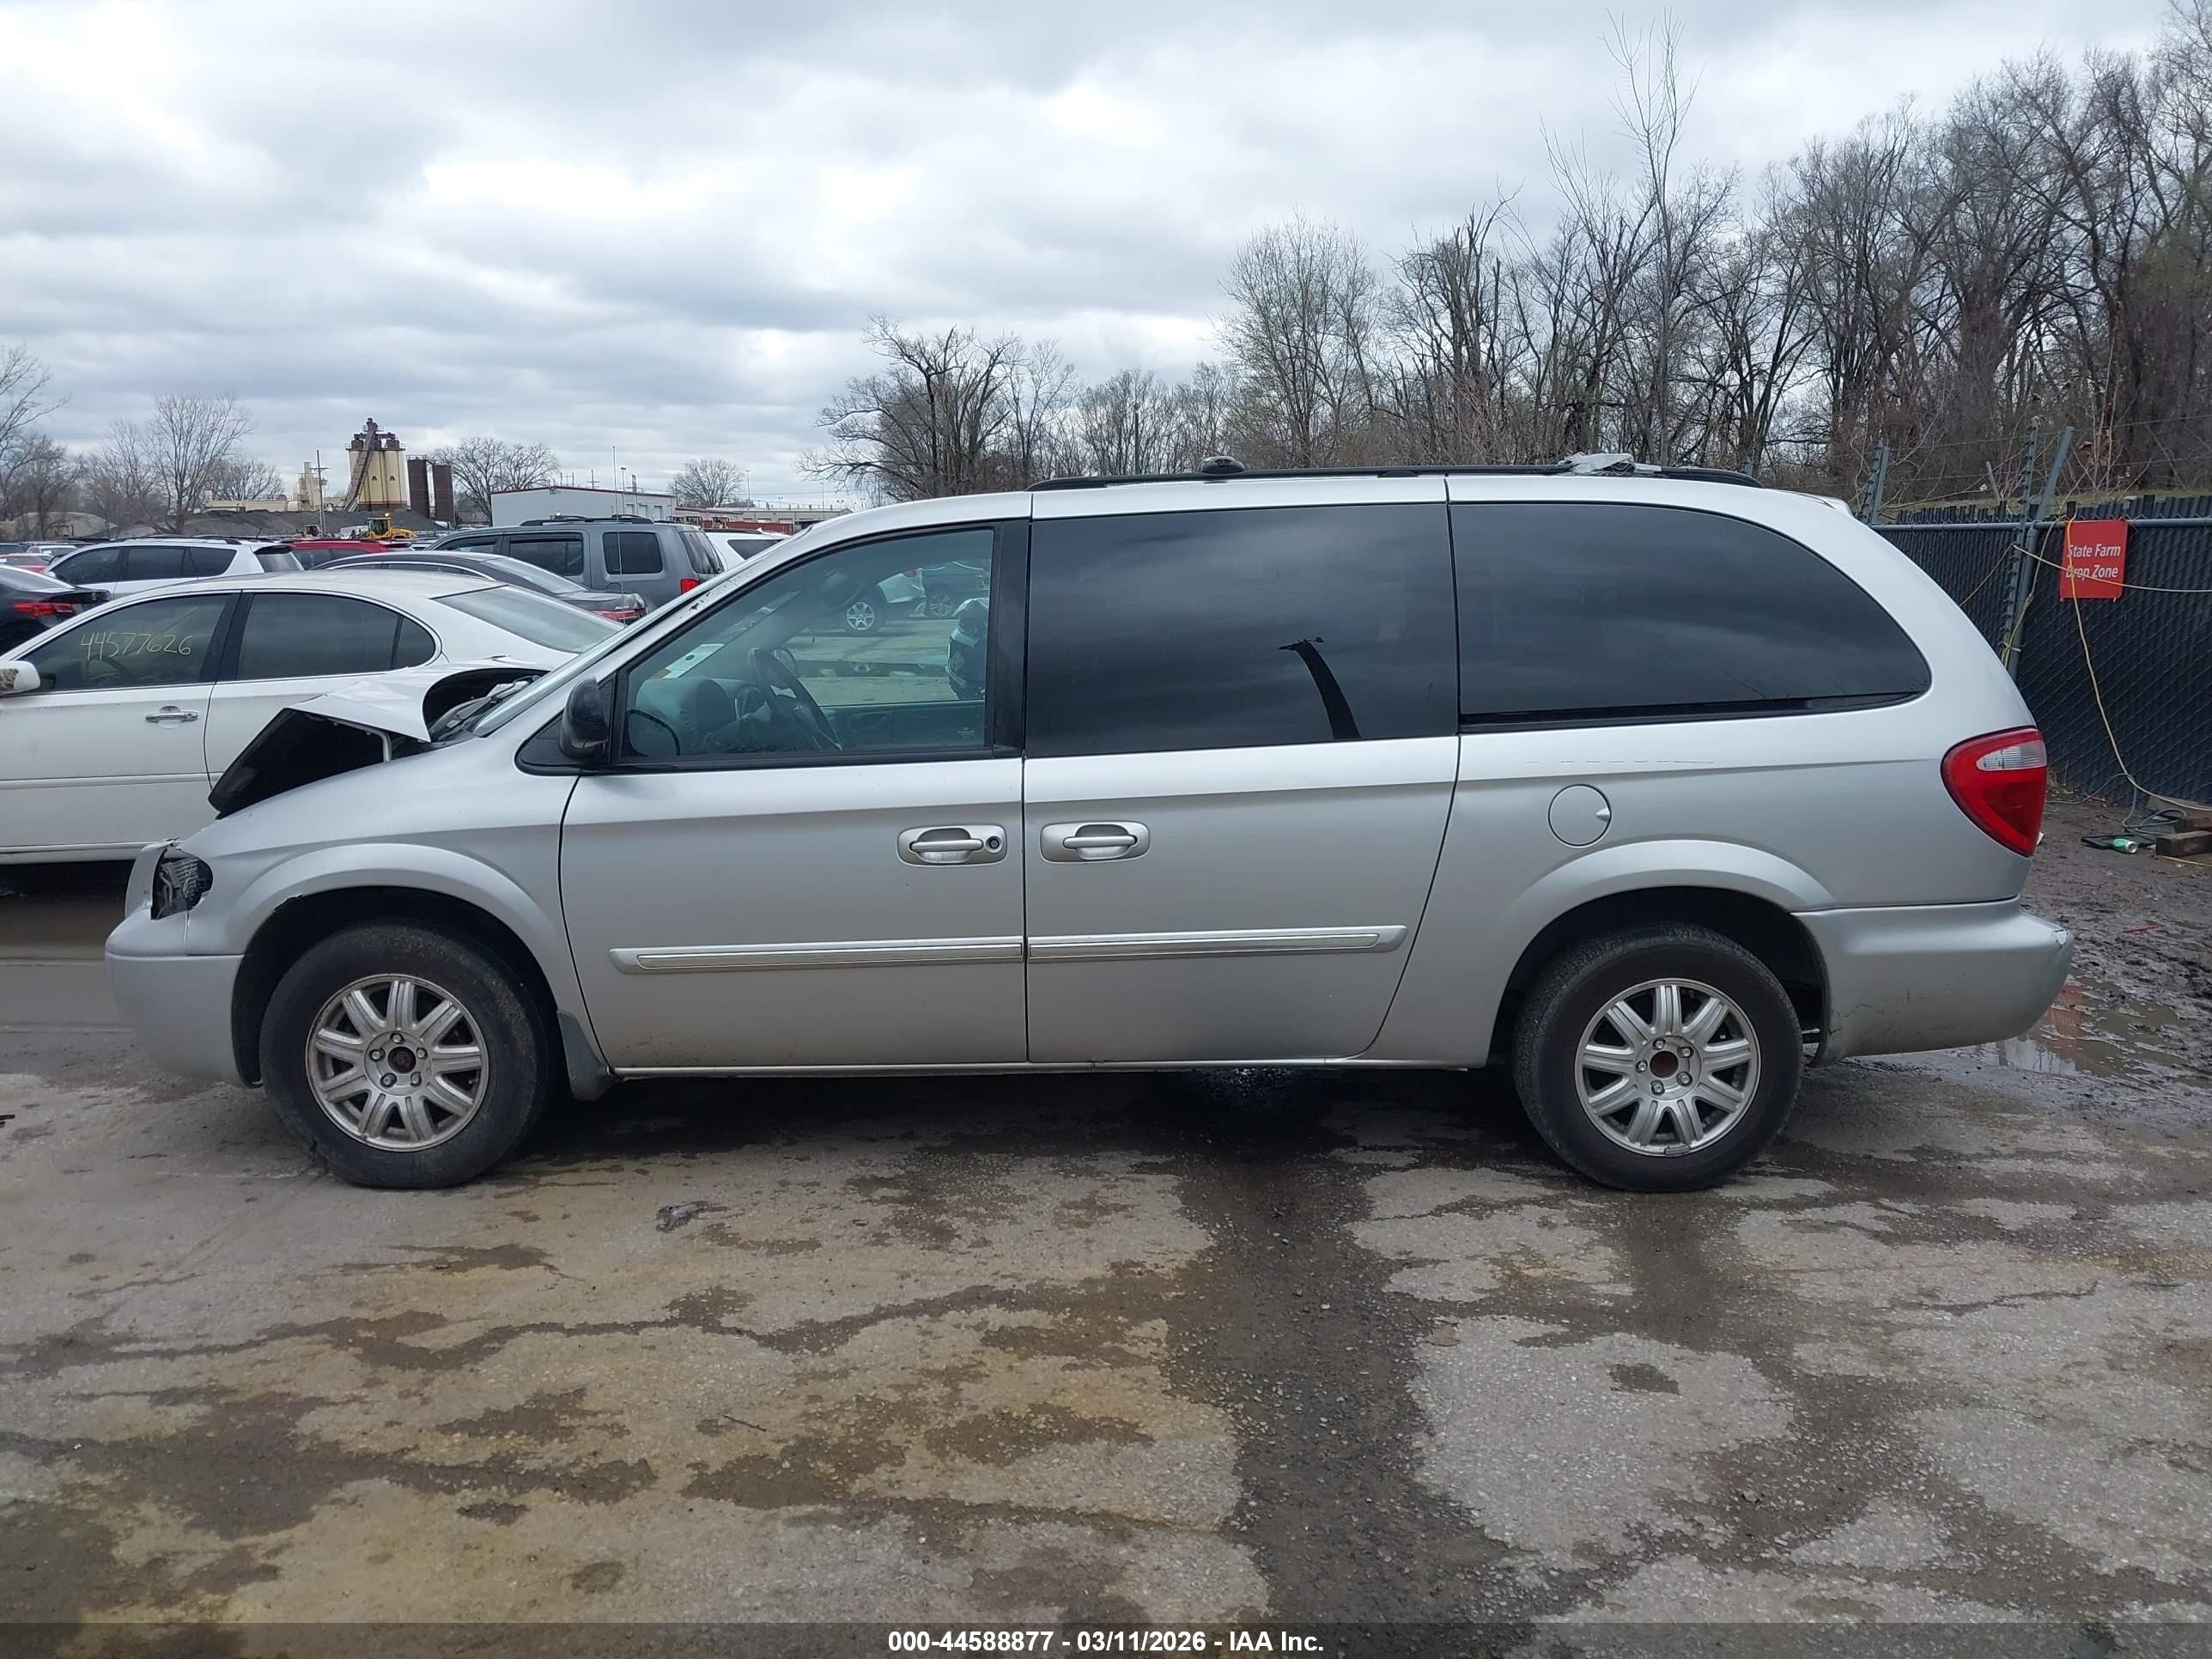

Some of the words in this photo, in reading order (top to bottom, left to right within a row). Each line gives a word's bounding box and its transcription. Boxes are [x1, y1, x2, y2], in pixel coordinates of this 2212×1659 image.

[2094, 544, 2121, 556] Farm
[2092, 565, 2118, 577] Zone
[81, 632, 192, 660] 44577626
